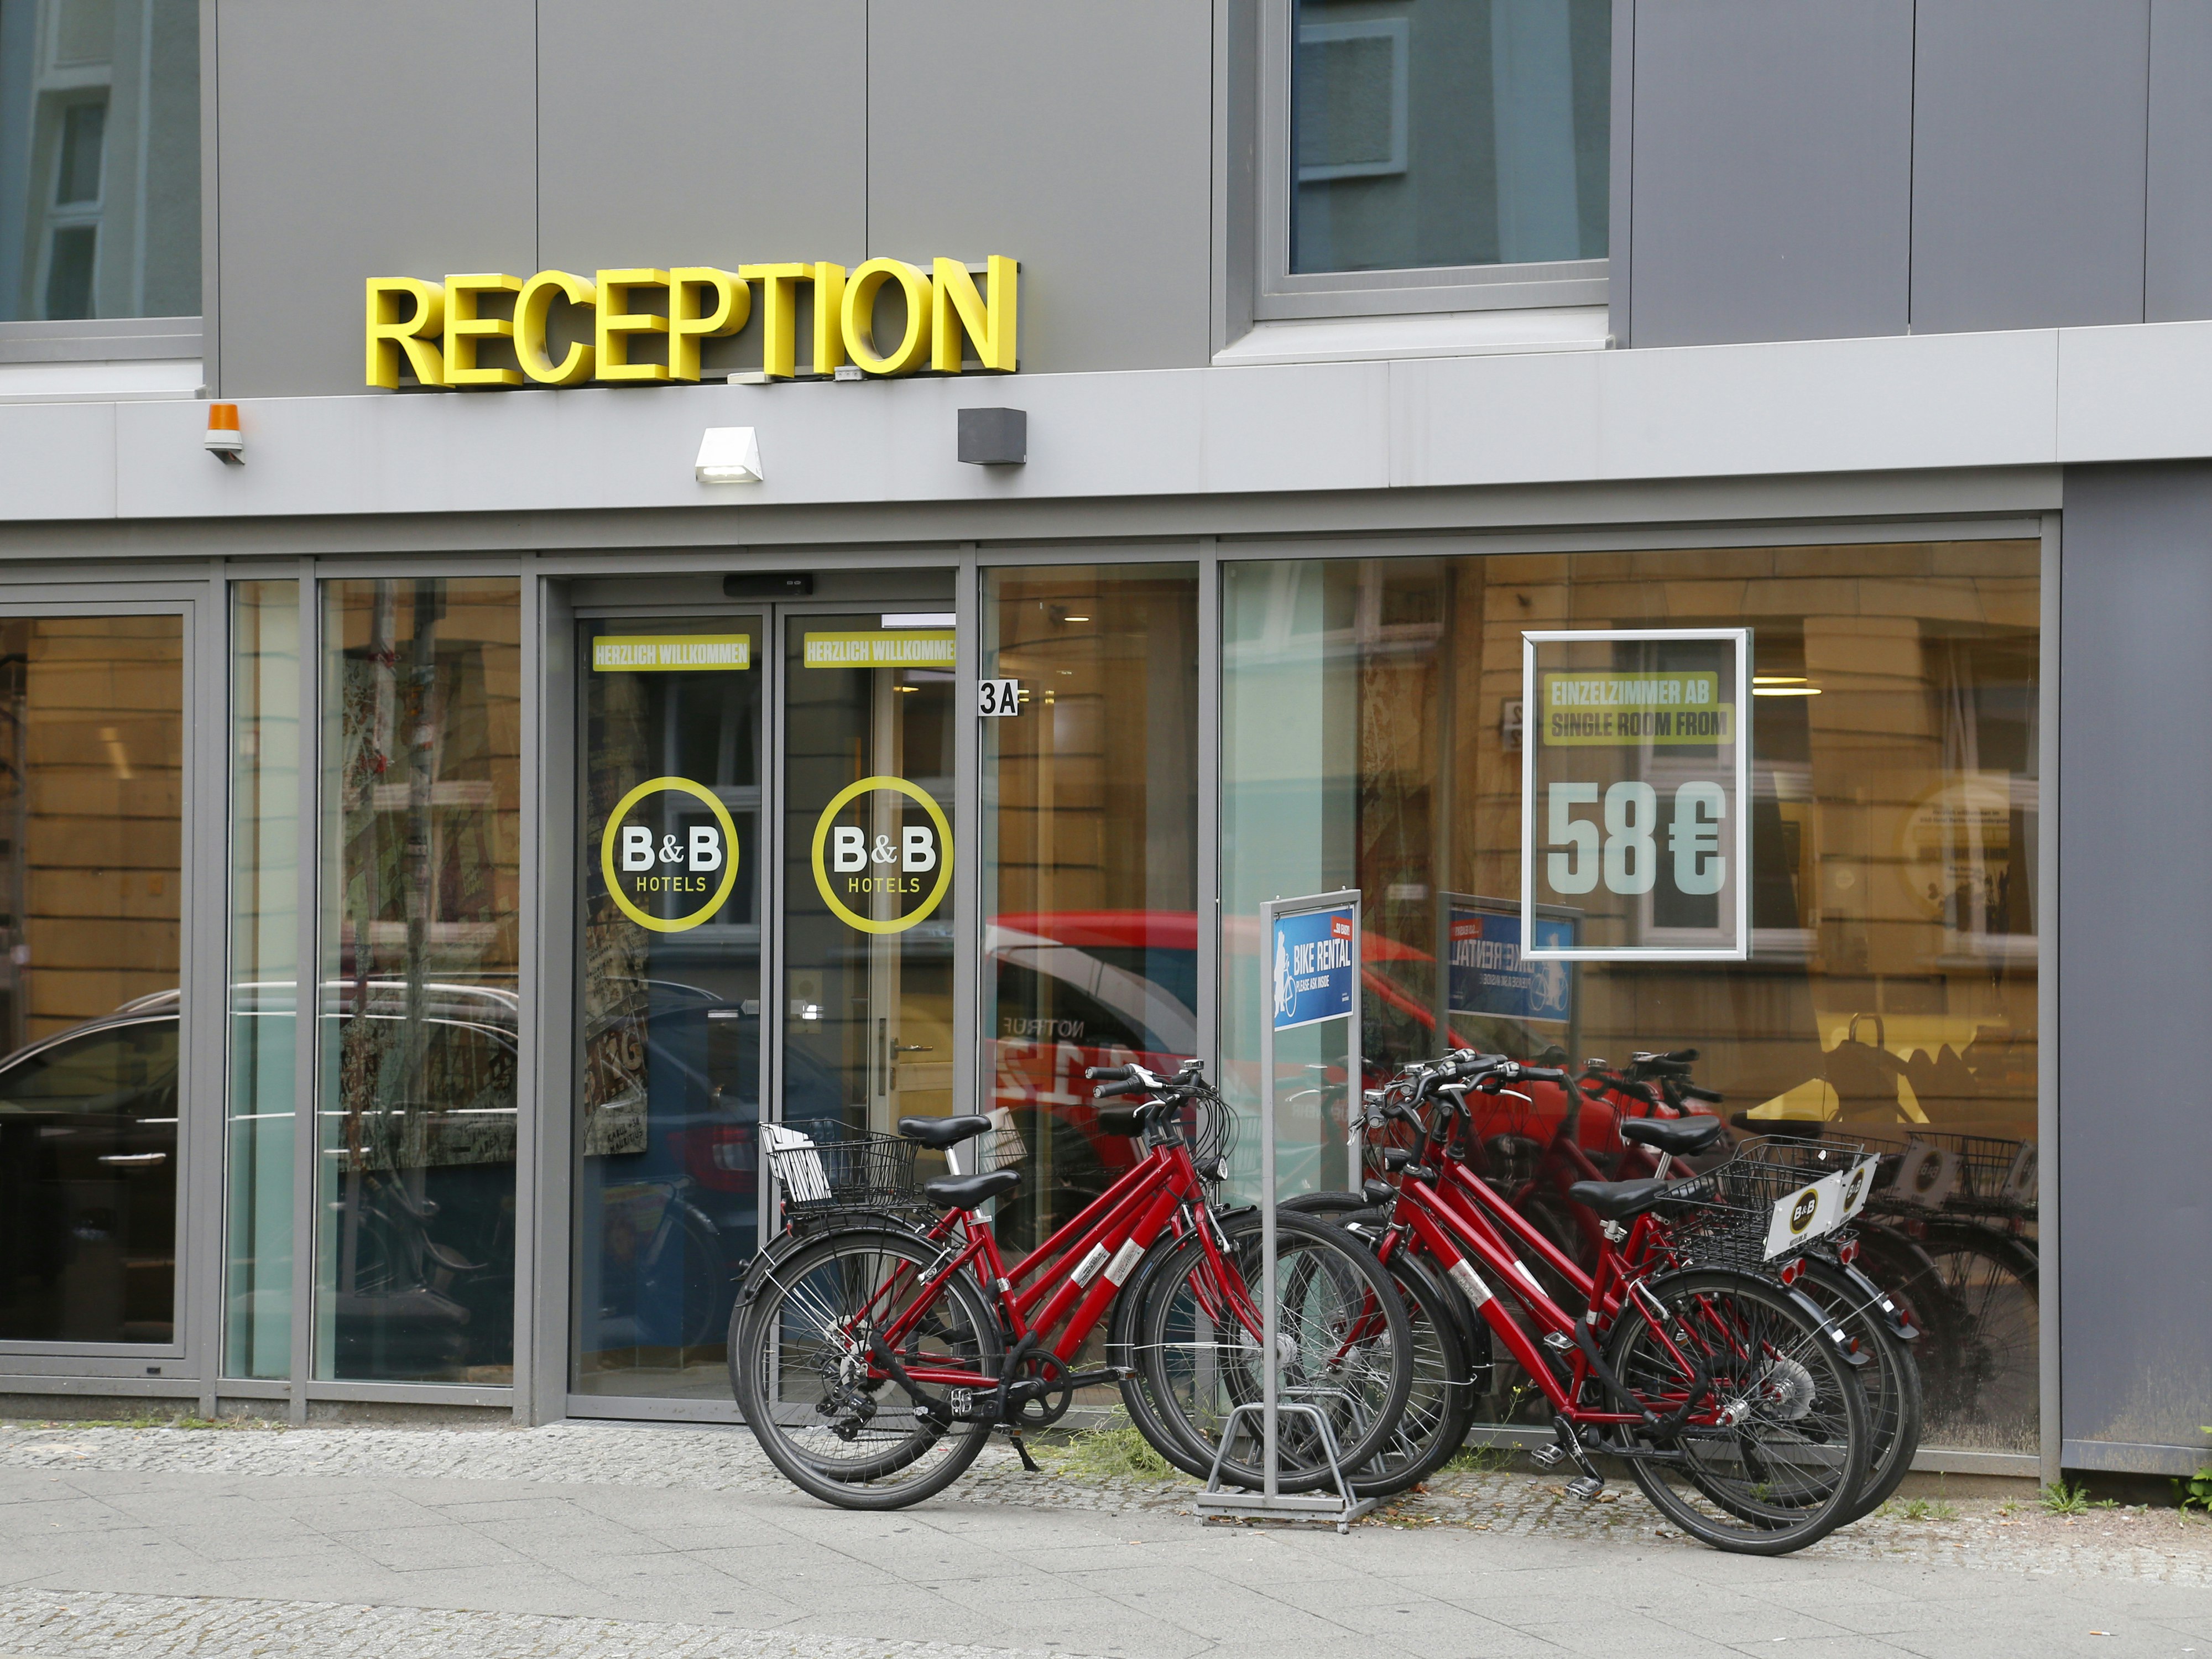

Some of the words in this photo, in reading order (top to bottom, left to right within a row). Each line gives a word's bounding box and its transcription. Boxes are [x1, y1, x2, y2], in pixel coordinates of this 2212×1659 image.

[366, 256, 1019, 389] RECEPTION
[596, 644, 656, 666] HERZLICH
[659, 643, 748, 665] WILLKOMMEN
[807, 641, 869, 661] HERZLICH
[872, 639, 956, 661] WILLKOMME
[980, 683, 1016, 714] 3A
[1552, 680, 1681, 706] EINZELZIMMER
[1684, 680, 1709, 704] AB
[1552, 712, 1613, 737] SINGLE
[1618, 712, 1671, 737] ROOM
[1676, 711, 1728, 735] FROM
[623, 826, 722, 872] B&B
[834, 826, 937, 872] B&B
[1547, 781, 1657, 895] 58
[637, 877, 706, 892] HOTELS
[848, 878, 920, 893] HOTELS
[1294, 942, 1315, 976] BIKE
[1317, 938, 1351, 972] RENTAL
[1296, 978, 1310, 993] PLEASE
[1318, 975, 1329, 989] INSIDE
[1847, 1180, 1861, 1199] B&B
[1793, 1199, 1815, 1221] B&B
